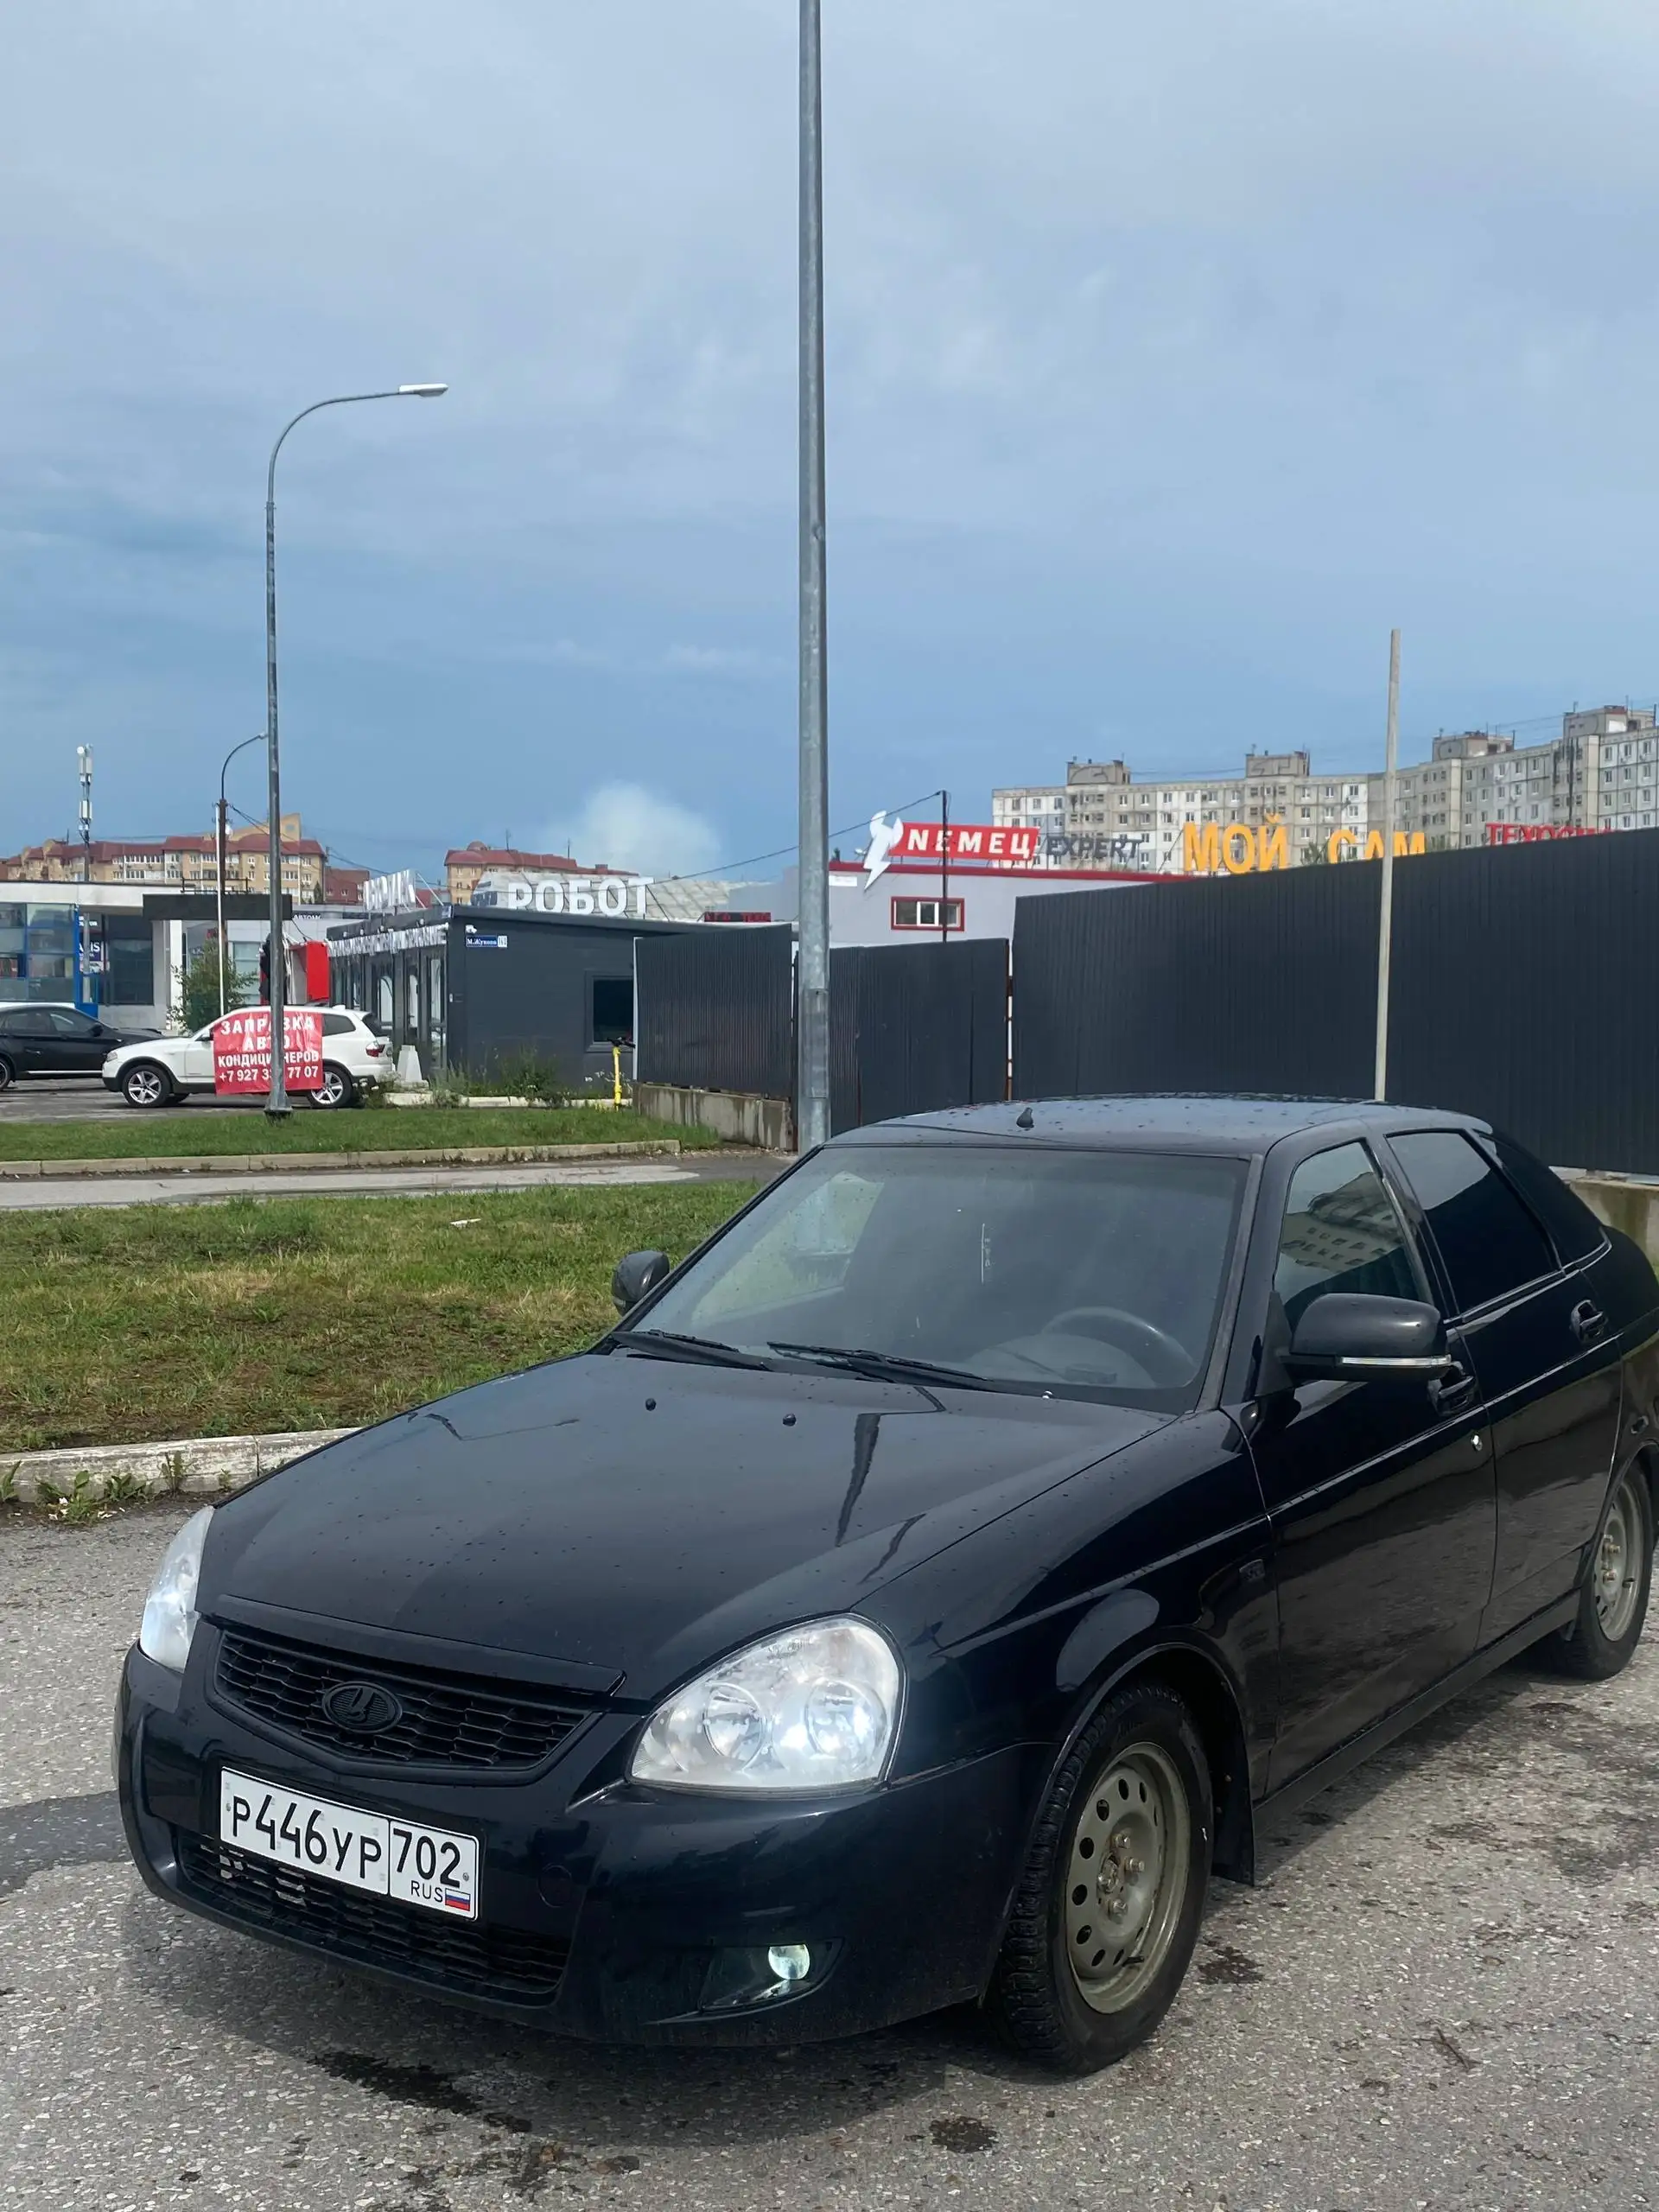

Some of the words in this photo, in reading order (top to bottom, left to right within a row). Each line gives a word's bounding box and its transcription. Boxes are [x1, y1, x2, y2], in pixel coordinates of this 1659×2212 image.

[1183, 810, 1288, 874] МОЙ
[508, 876, 654, 918] РОБОТ
[220, 1016, 315, 1035] ЗАПРВКА
[218, 1051, 319, 1067] КОНДИЦИНЕРОВ
[237, 1069, 258, 1081] 927
[287, 1067, 302, 1078] 77
[304, 1065, 319, 1077] 07
[232, 1794, 382, 1880] Р446УР
[392, 1827, 461, 1889] 702
[410, 1879, 444, 1904] RUS
